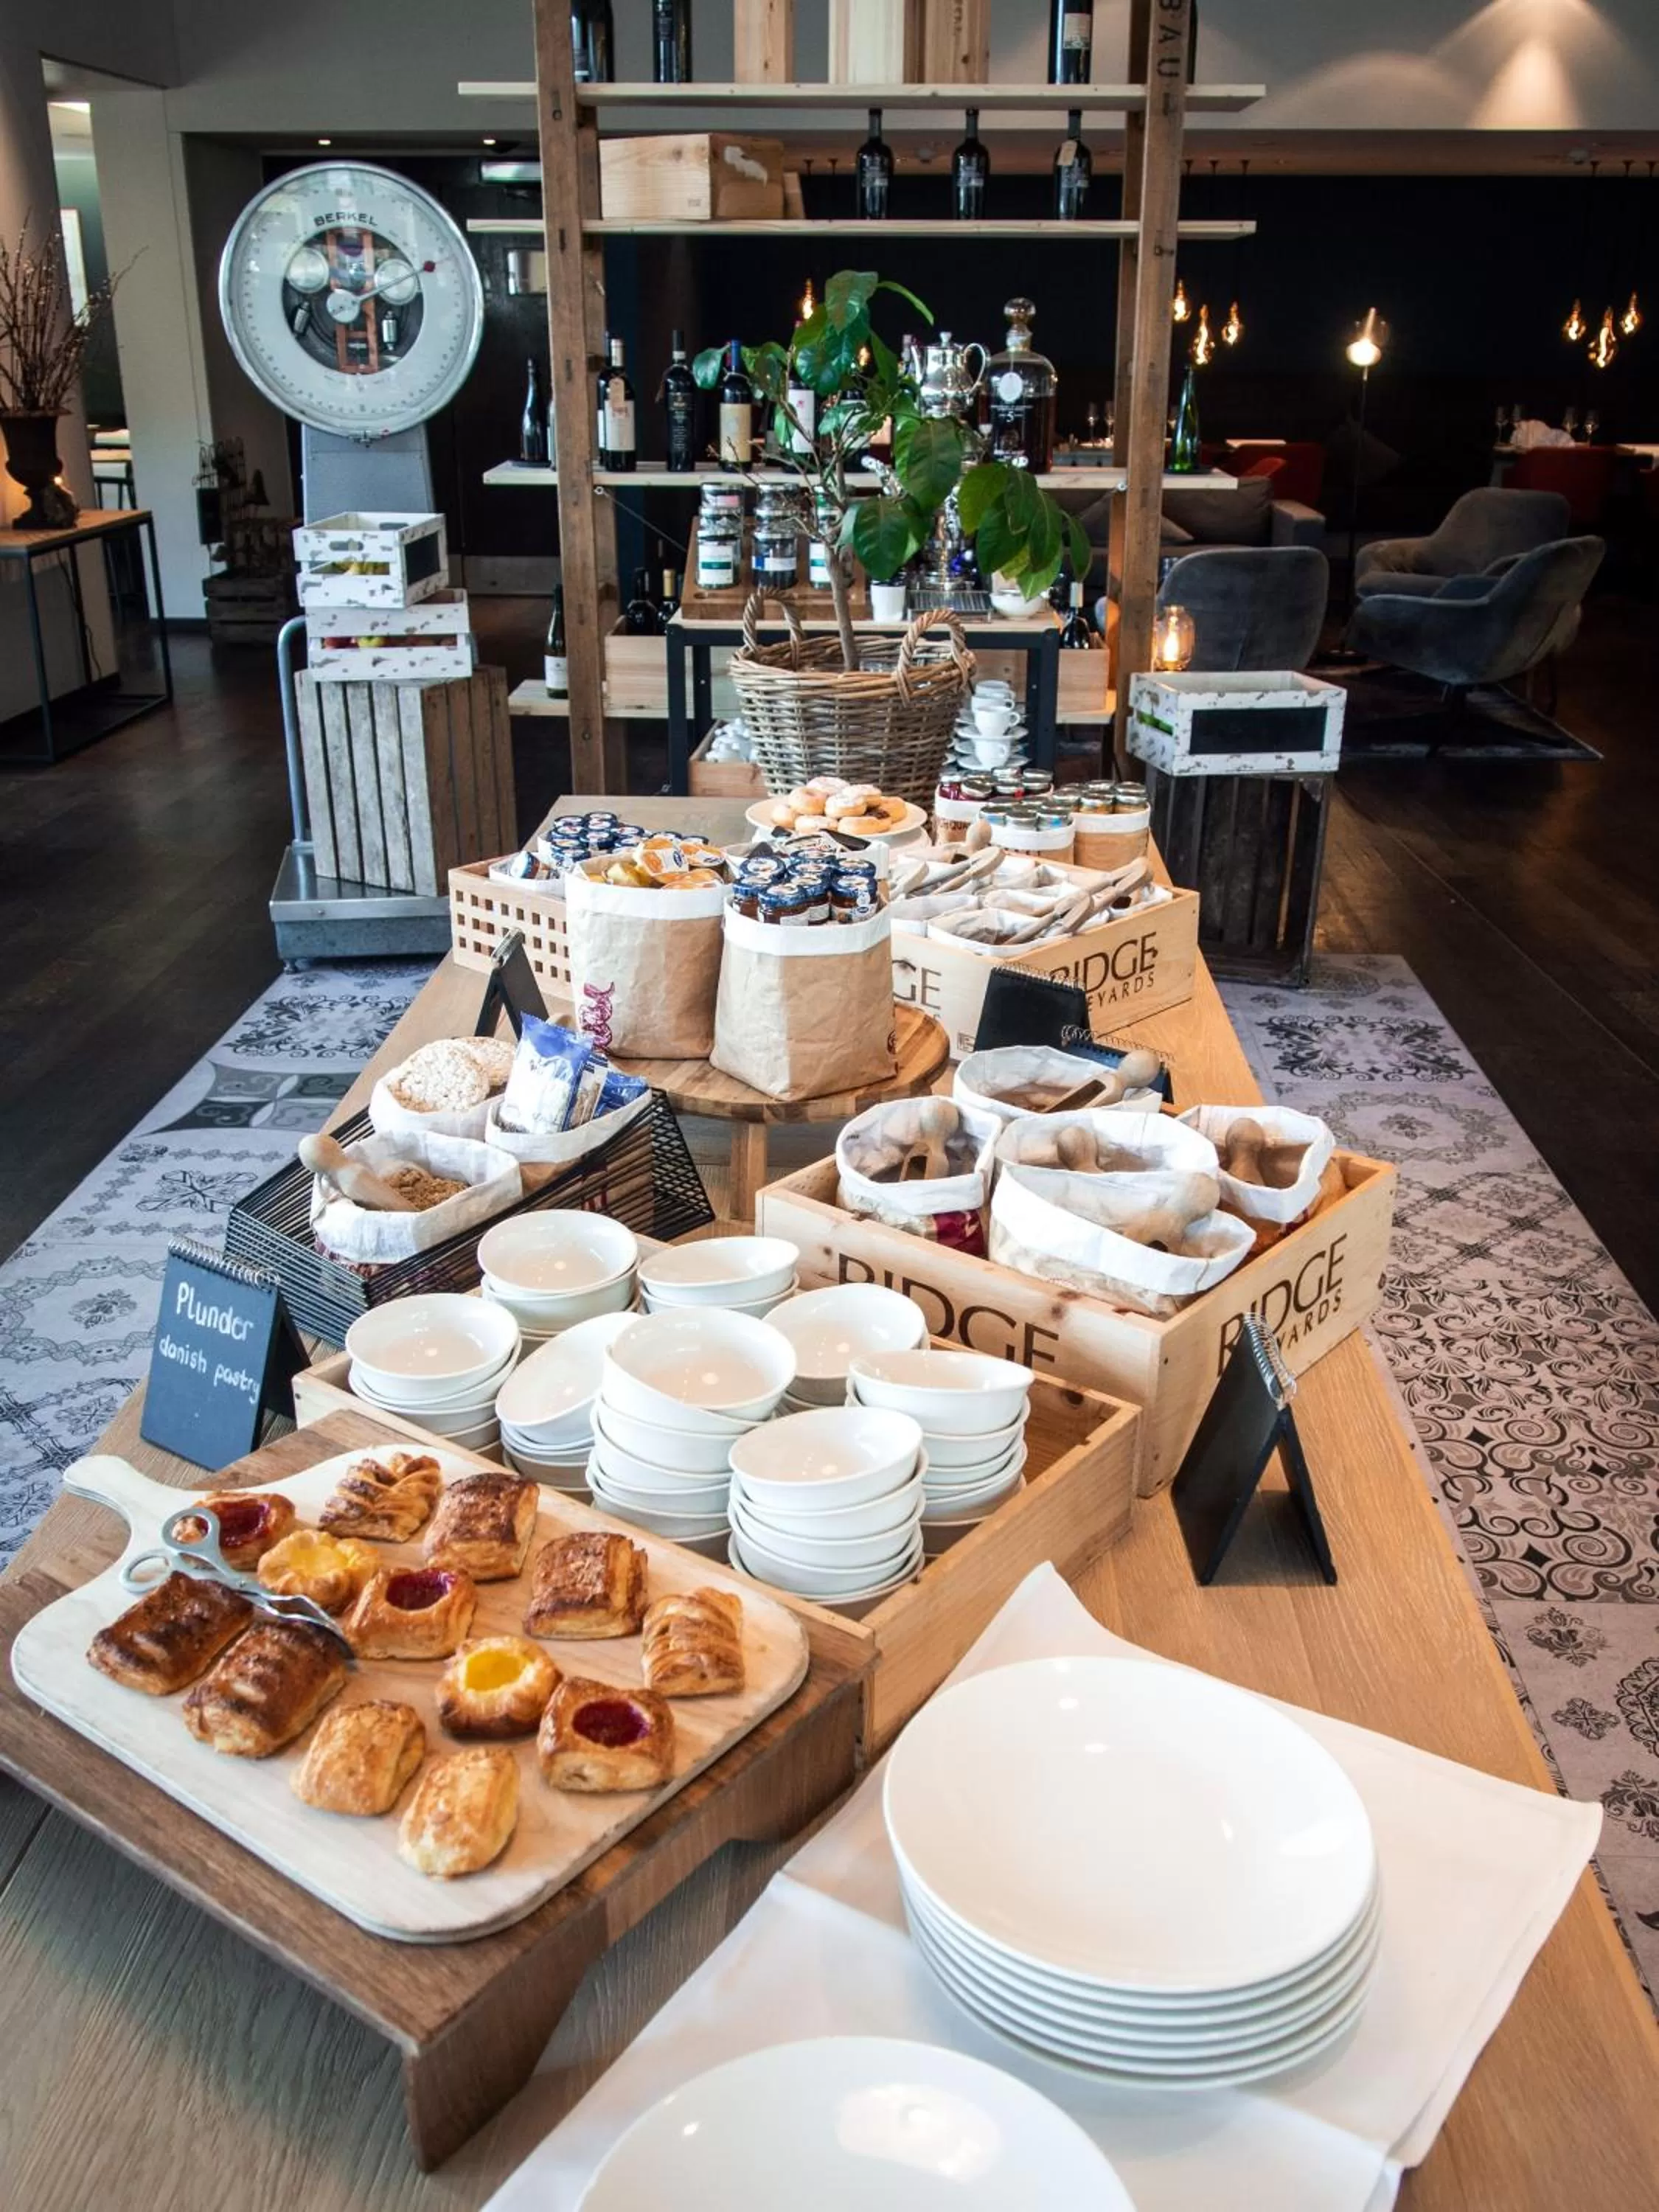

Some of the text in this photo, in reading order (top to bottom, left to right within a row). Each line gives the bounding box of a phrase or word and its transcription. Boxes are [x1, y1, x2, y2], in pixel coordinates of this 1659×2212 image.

[313, 212, 378, 227] BERKEL
[1087, 971, 1155, 1012] EYARDS
[176, 1281, 254, 1340] Plunder
[1276, 1288, 1342, 1351] YARDS
[159, 1335, 262, 1403] danish pastry
